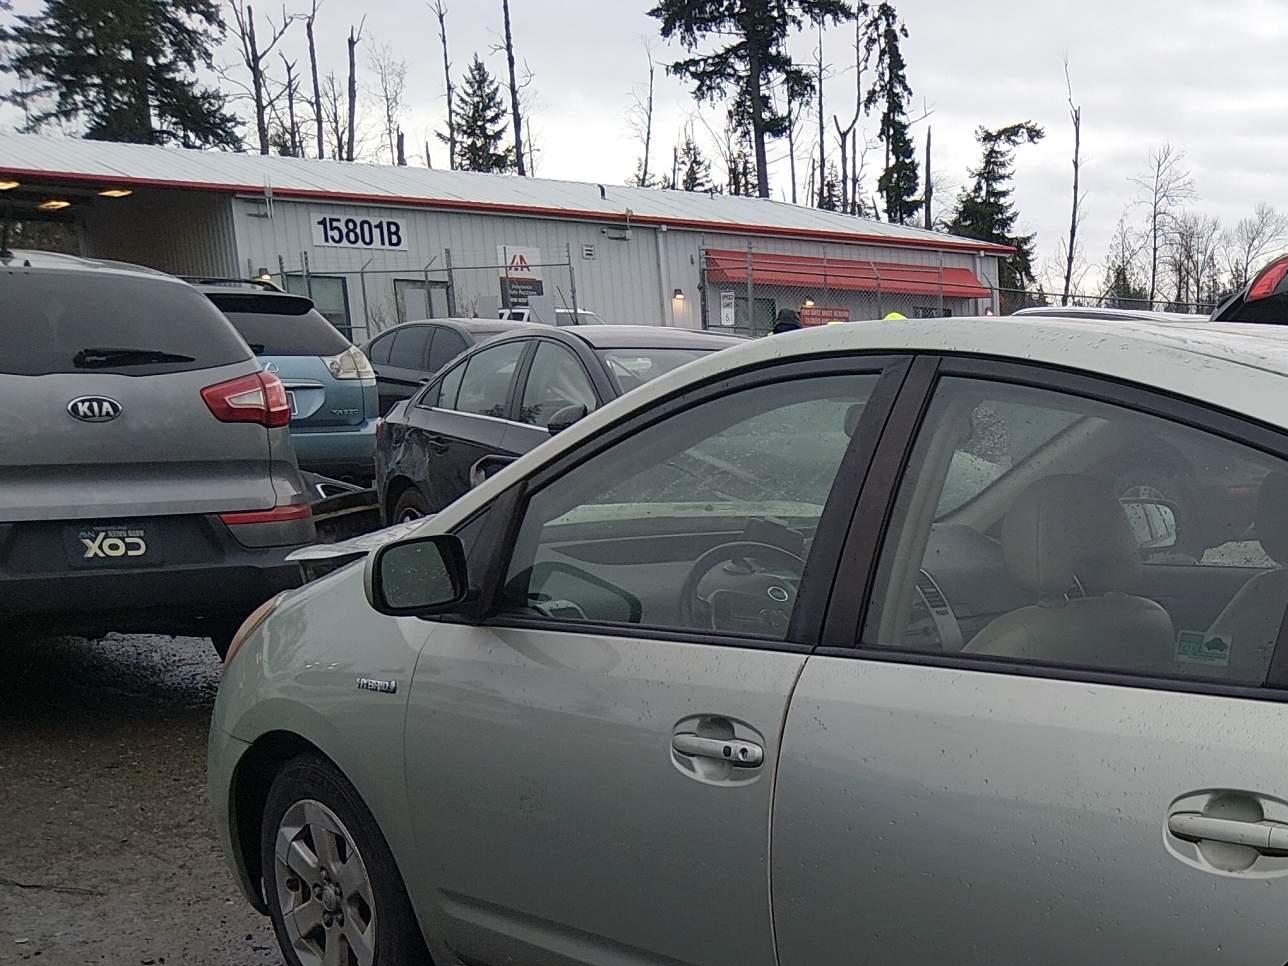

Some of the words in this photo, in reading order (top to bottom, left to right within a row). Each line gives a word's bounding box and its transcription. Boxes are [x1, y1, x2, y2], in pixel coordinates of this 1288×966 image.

[317, 216, 402, 247] 15801B
[77, 401, 115, 417] KIA
[80, 532, 146, 558] COX
